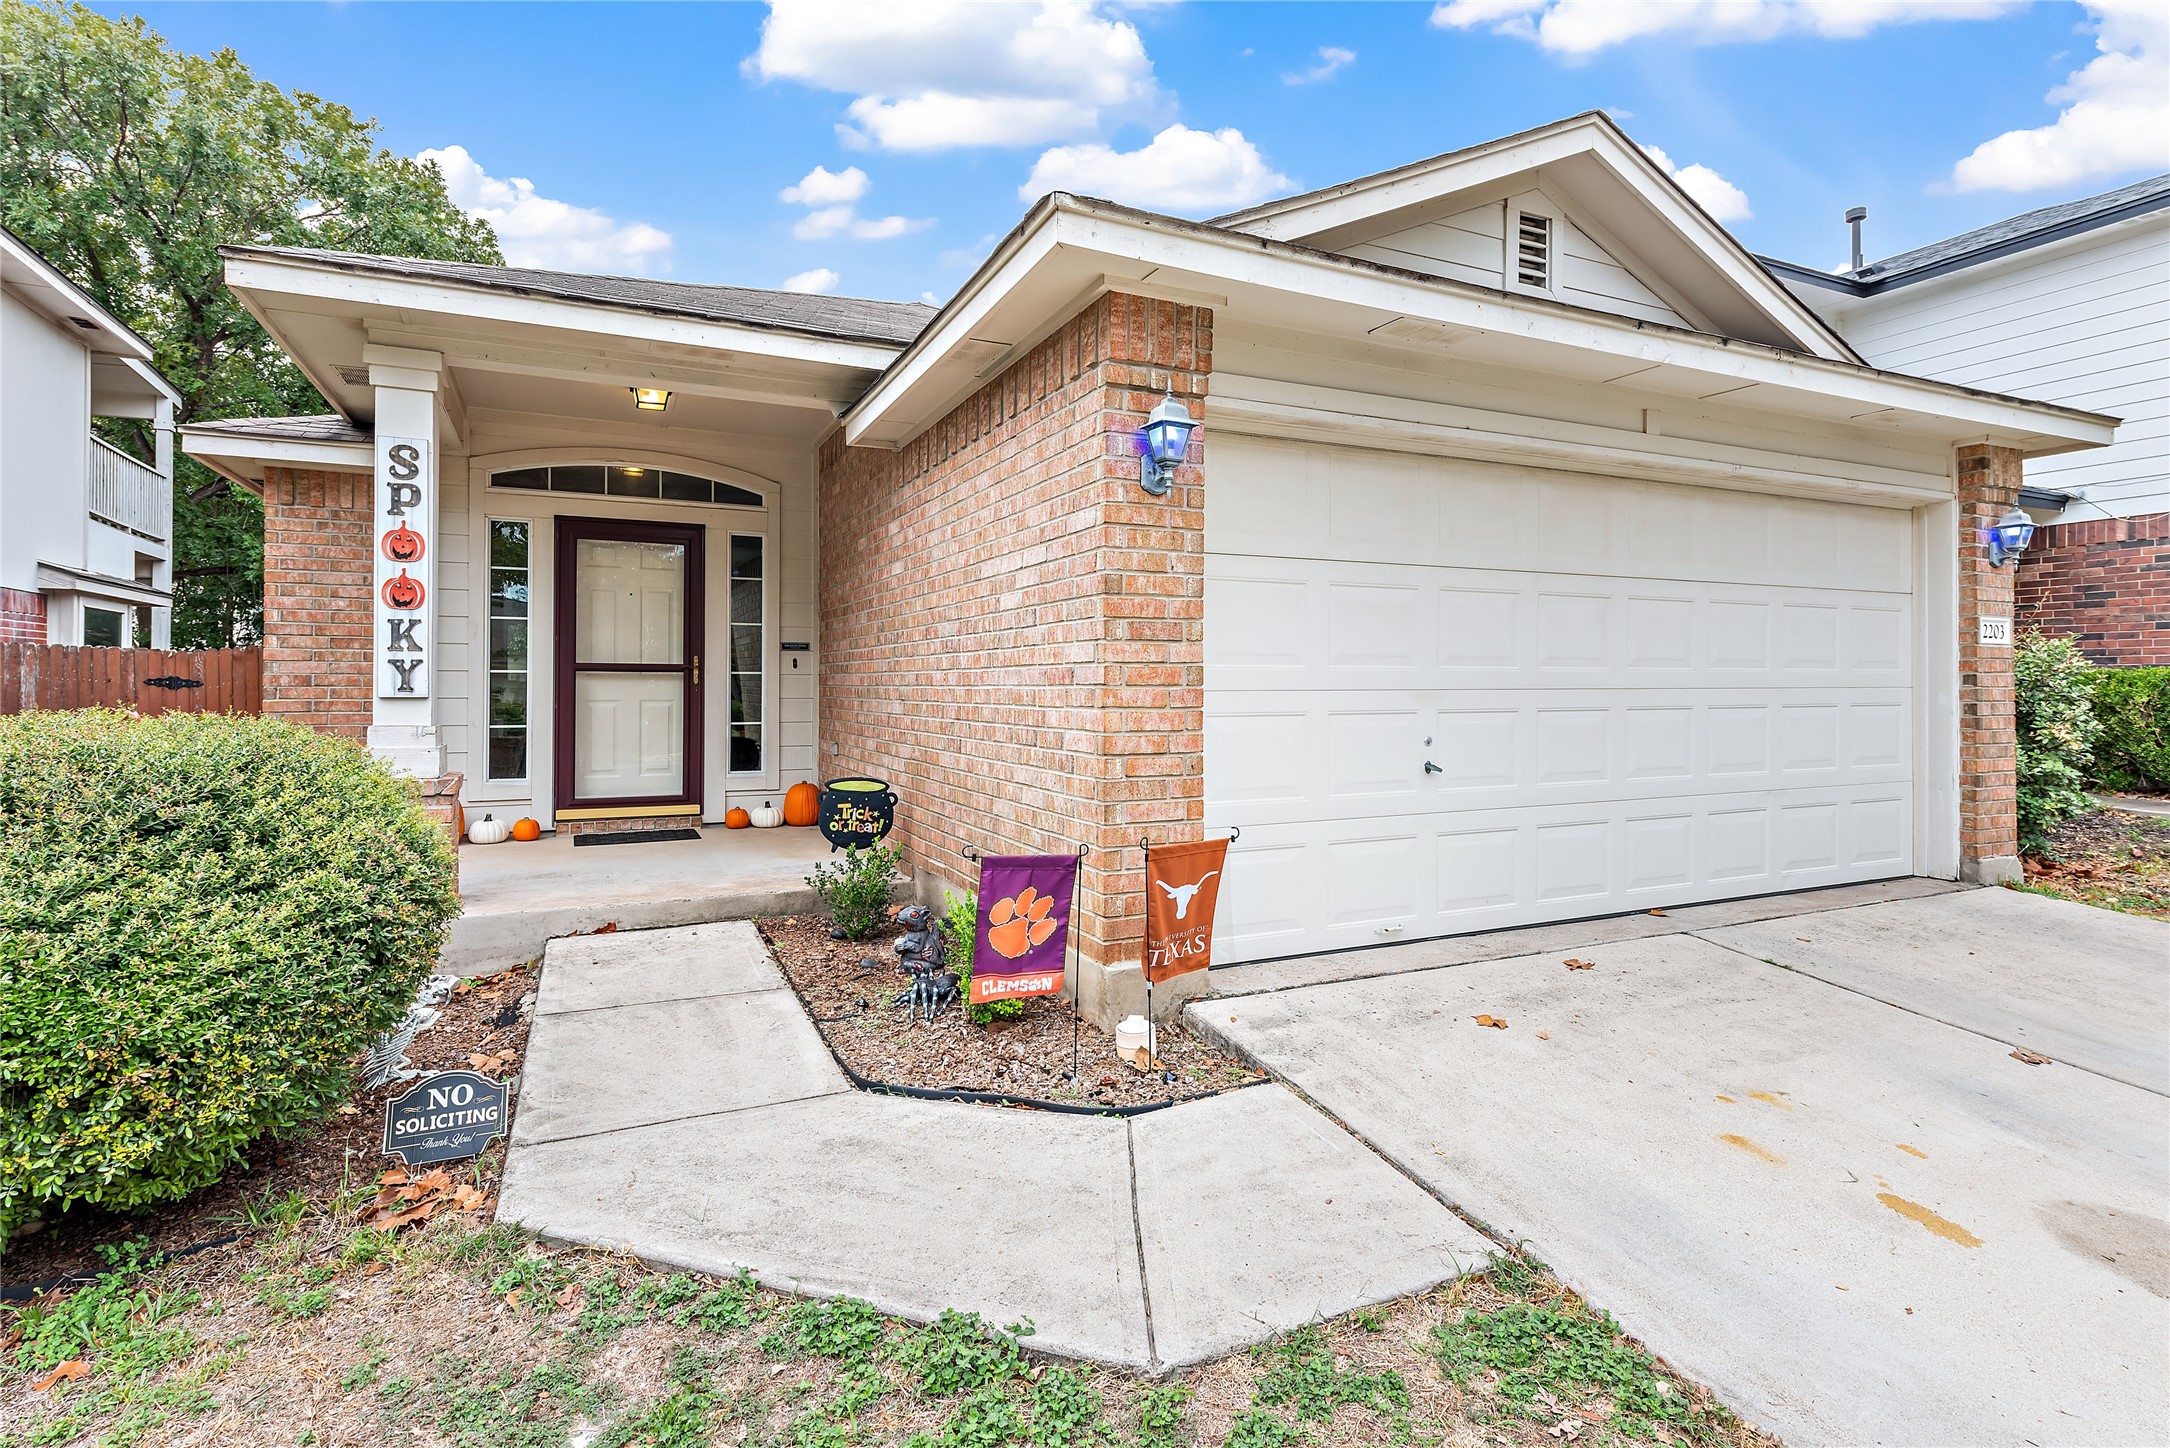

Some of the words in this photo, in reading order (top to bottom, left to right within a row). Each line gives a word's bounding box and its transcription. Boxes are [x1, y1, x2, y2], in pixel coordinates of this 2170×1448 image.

[381, 444, 425, 692] SPOOKY
[1983, 624, 2005, 640] 2203
[837, 803, 874, 821] Trick
[829, 820, 845, 831] or
[847, 818, 884, 833] treat!
[1164, 927, 1196, 943] NIVERSITY
[1149, 934, 1206, 967] TEXAS
[981, 977, 1053, 996] CLEMSON
[426, 1083, 474, 1110] NO
[395, 1106, 498, 1135] SOLICITING
[420, 1136, 451, 1150] Thank
